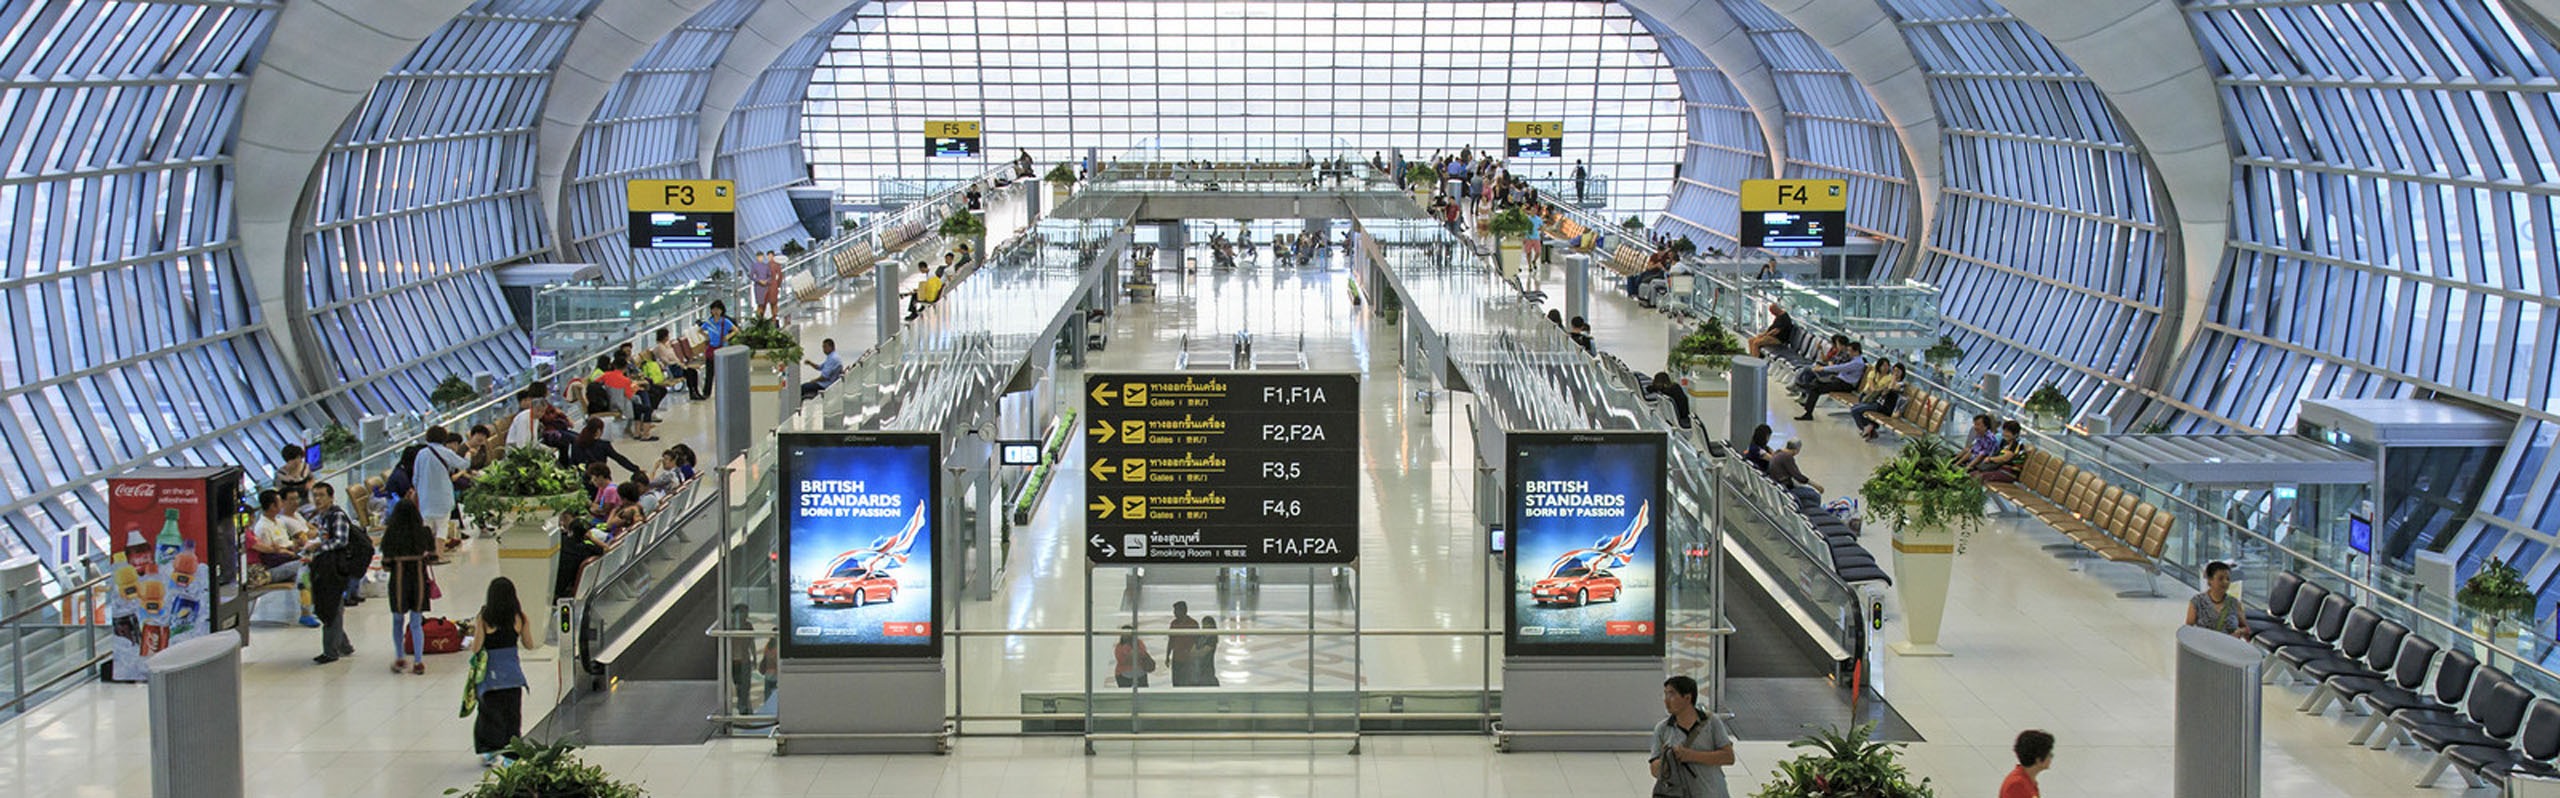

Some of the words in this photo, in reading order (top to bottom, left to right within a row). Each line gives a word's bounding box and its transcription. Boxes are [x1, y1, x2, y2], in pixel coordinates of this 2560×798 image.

[944, 123, 960, 135] F5
[1526, 124, 1543, 135] F6
[665, 185, 695, 206] F3
[1778, 185, 1808, 205] F4
[1263, 386, 1326, 405] F1,F1A
[1151, 398, 1175, 407] Gates
[1149, 435, 1173, 444] Gates
[1263, 424, 1326, 443] F2,F2A
[1150, 473, 1174, 482] Gates
[1263, 462, 1301, 480] F3,5
[801, 480, 865, 493] BRITISH
[1526, 480, 1589, 493] BRITISH
[801, 494, 902, 507] STANDARDS
[1526, 494, 1625, 507] STANDARDS
[801, 508, 833, 518] BORN
[835, 508, 850, 518] BY
[852, 508, 901, 518] PASSION
[1150, 511, 1174, 520] Gates
[1263, 500, 1301, 518] F4,6
[1526, 508, 1557, 517] BORN
[1559, 508, 1574, 517] BY
[1577, 508, 1625, 517] PASSION
[1150, 549, 1186, 558] Smoking
[1187, 549, 1212, 557] Room
